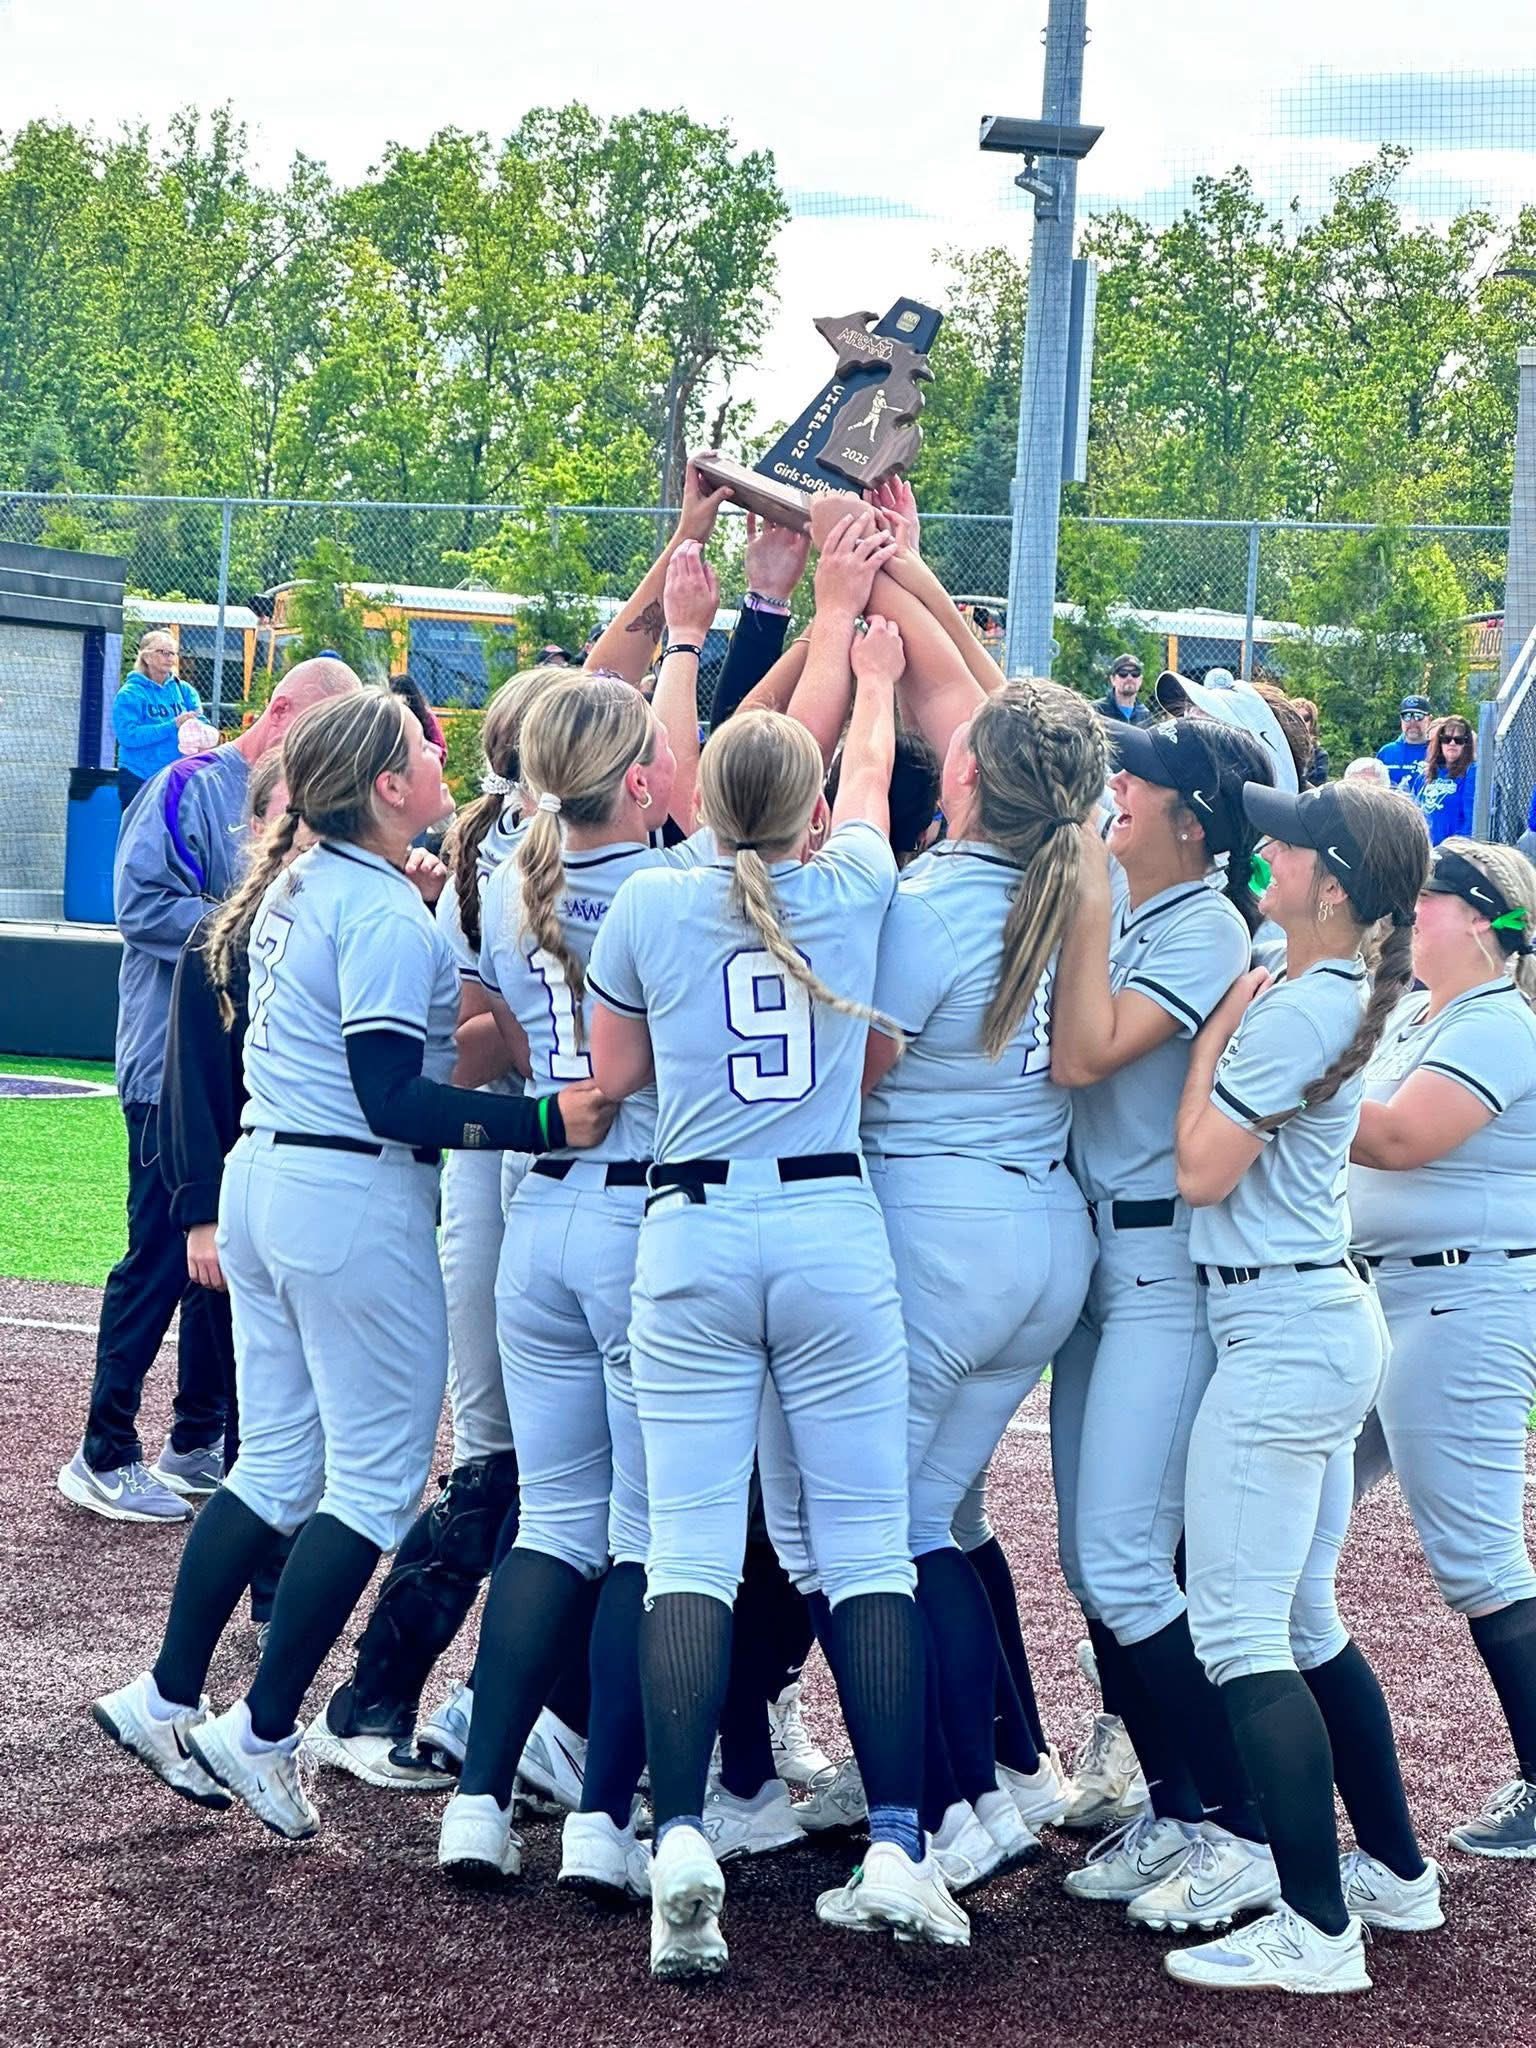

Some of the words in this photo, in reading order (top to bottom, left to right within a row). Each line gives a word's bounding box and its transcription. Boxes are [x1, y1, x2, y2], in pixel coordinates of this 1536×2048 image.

[791, 385, 845, 459] CHAMPION
[773, 462, 801, 481] Girls
[841, 447, 870, 465] 2025
[722, 945, 816, 1105] 9
